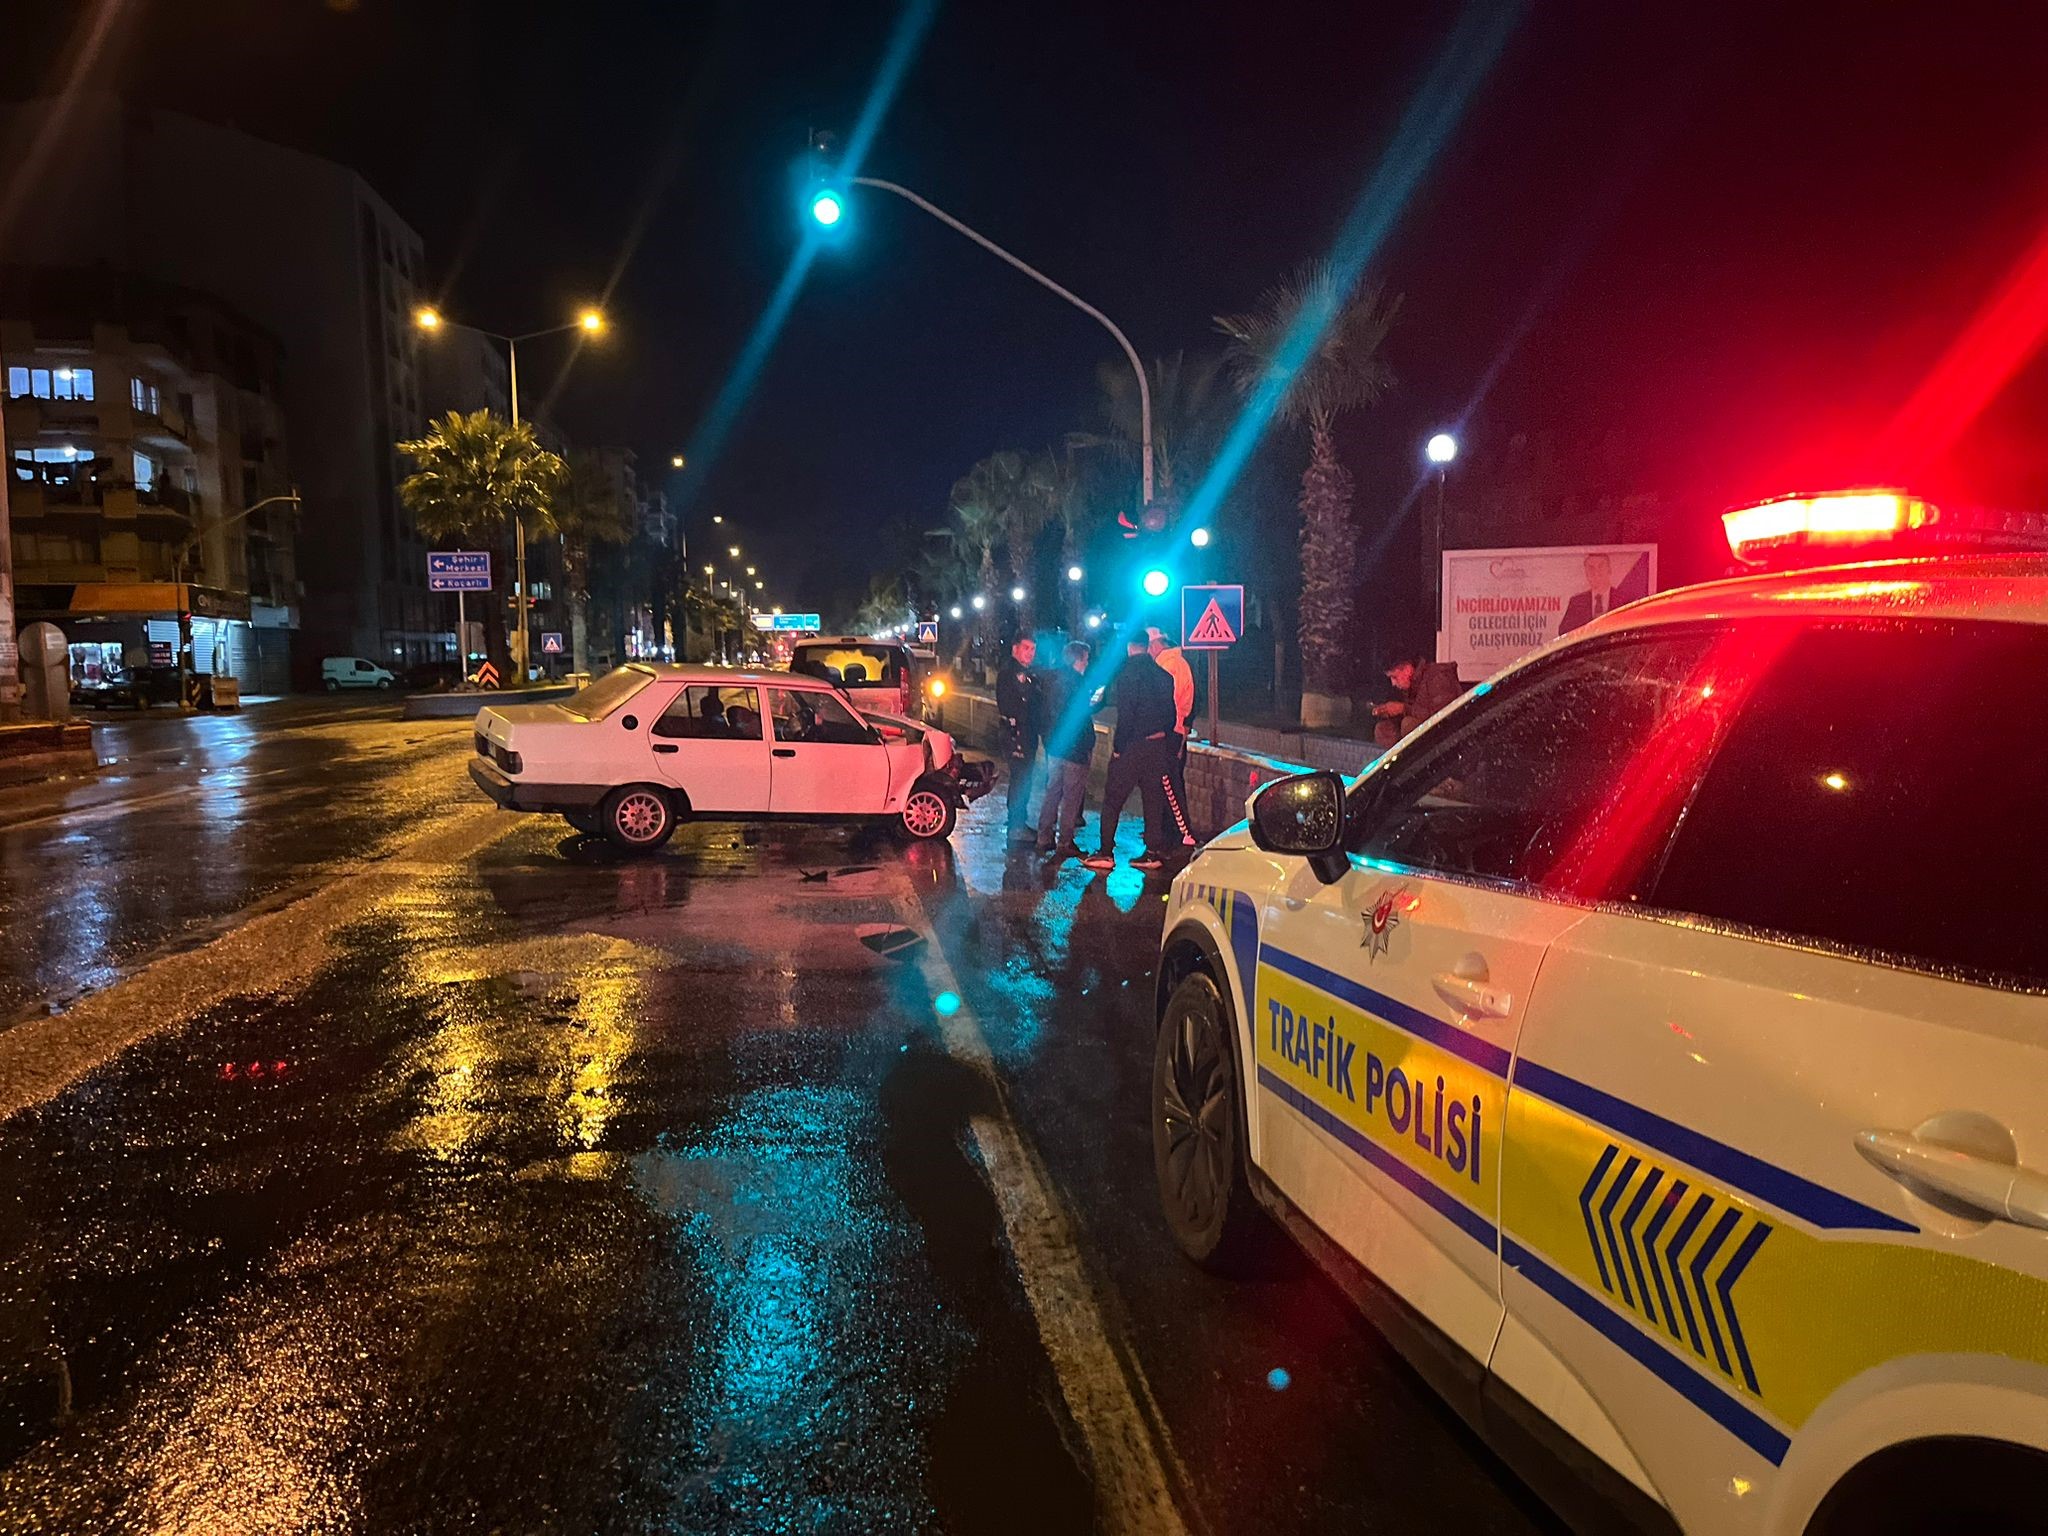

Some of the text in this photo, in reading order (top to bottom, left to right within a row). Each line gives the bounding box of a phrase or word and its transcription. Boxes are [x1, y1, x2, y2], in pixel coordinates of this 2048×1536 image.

[1469, 614, 1547, 632] GELECEĞİ İÇİN
[1470, 632, 1543, 650] ÇALIŞIYORUZ
[1268, 998, 1481, 1185] TRAFİK POLİSİ
